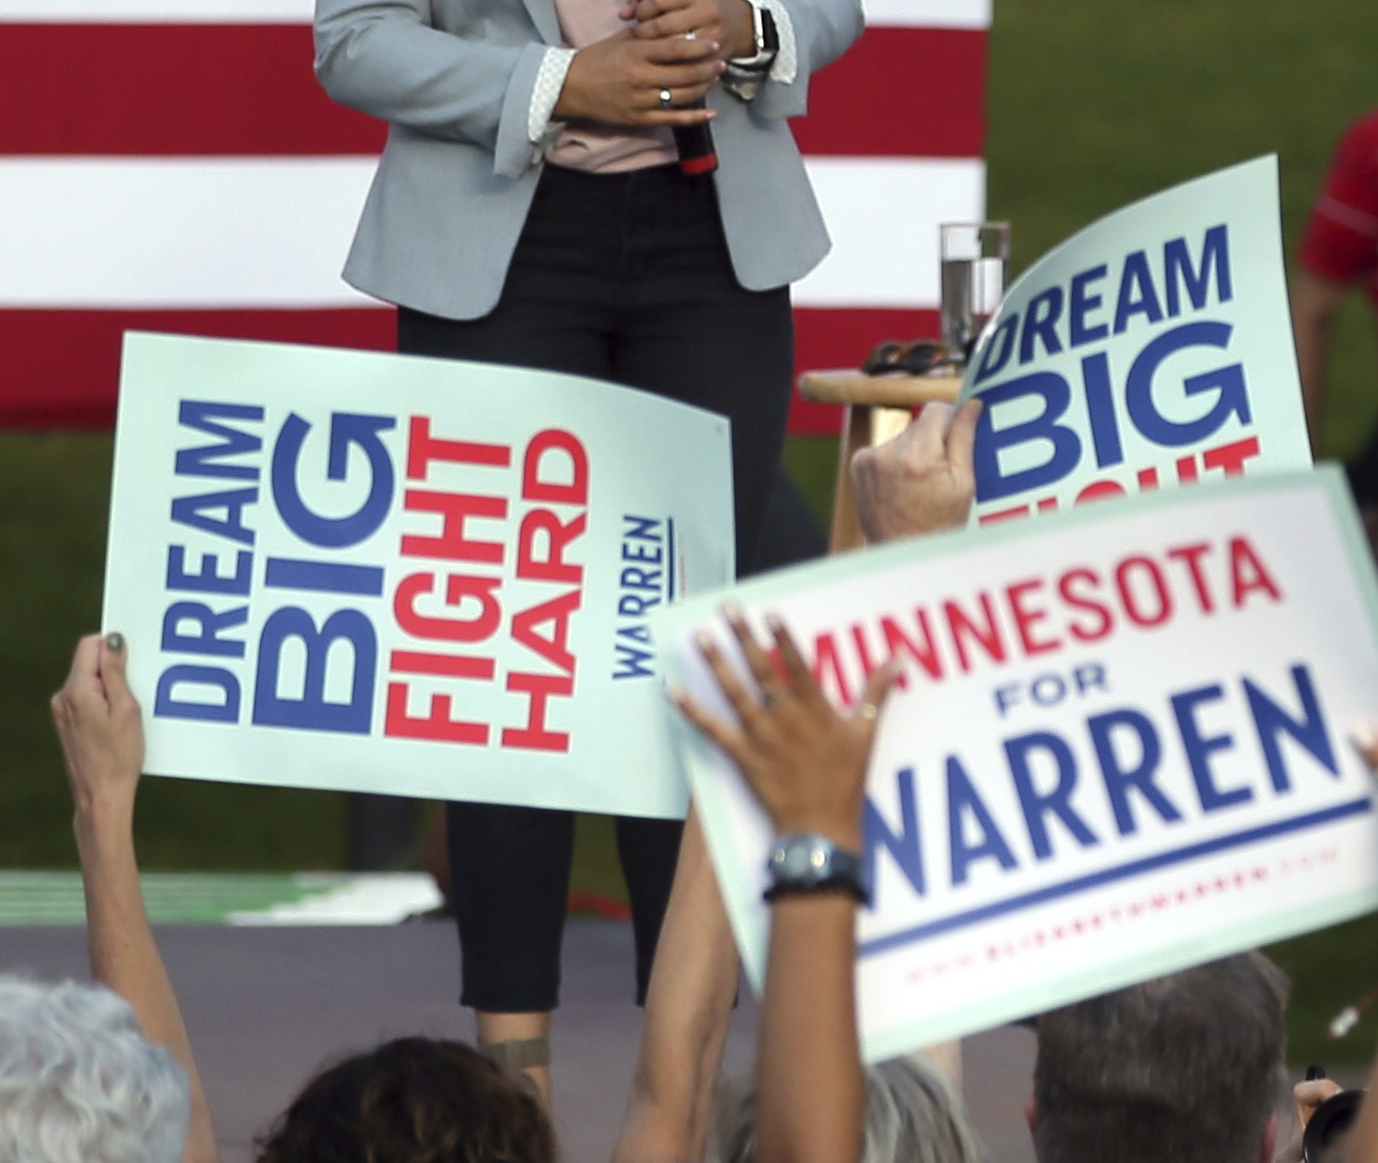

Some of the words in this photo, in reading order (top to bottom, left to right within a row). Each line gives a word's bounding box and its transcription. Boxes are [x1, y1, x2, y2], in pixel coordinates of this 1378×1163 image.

[972, 223, 1234, 387] DREAM
[973, 320, 1254, 504] BIG
[153, 399, 266, 724] DREAM
[252, 411, 398, 735] BIG
[384, 415, 512, 746] FIGHT
[501, 428, 589, 752] HARD
[611, 514, 663, 680] WARREN
[993, 661, 1110, 717] FOR
